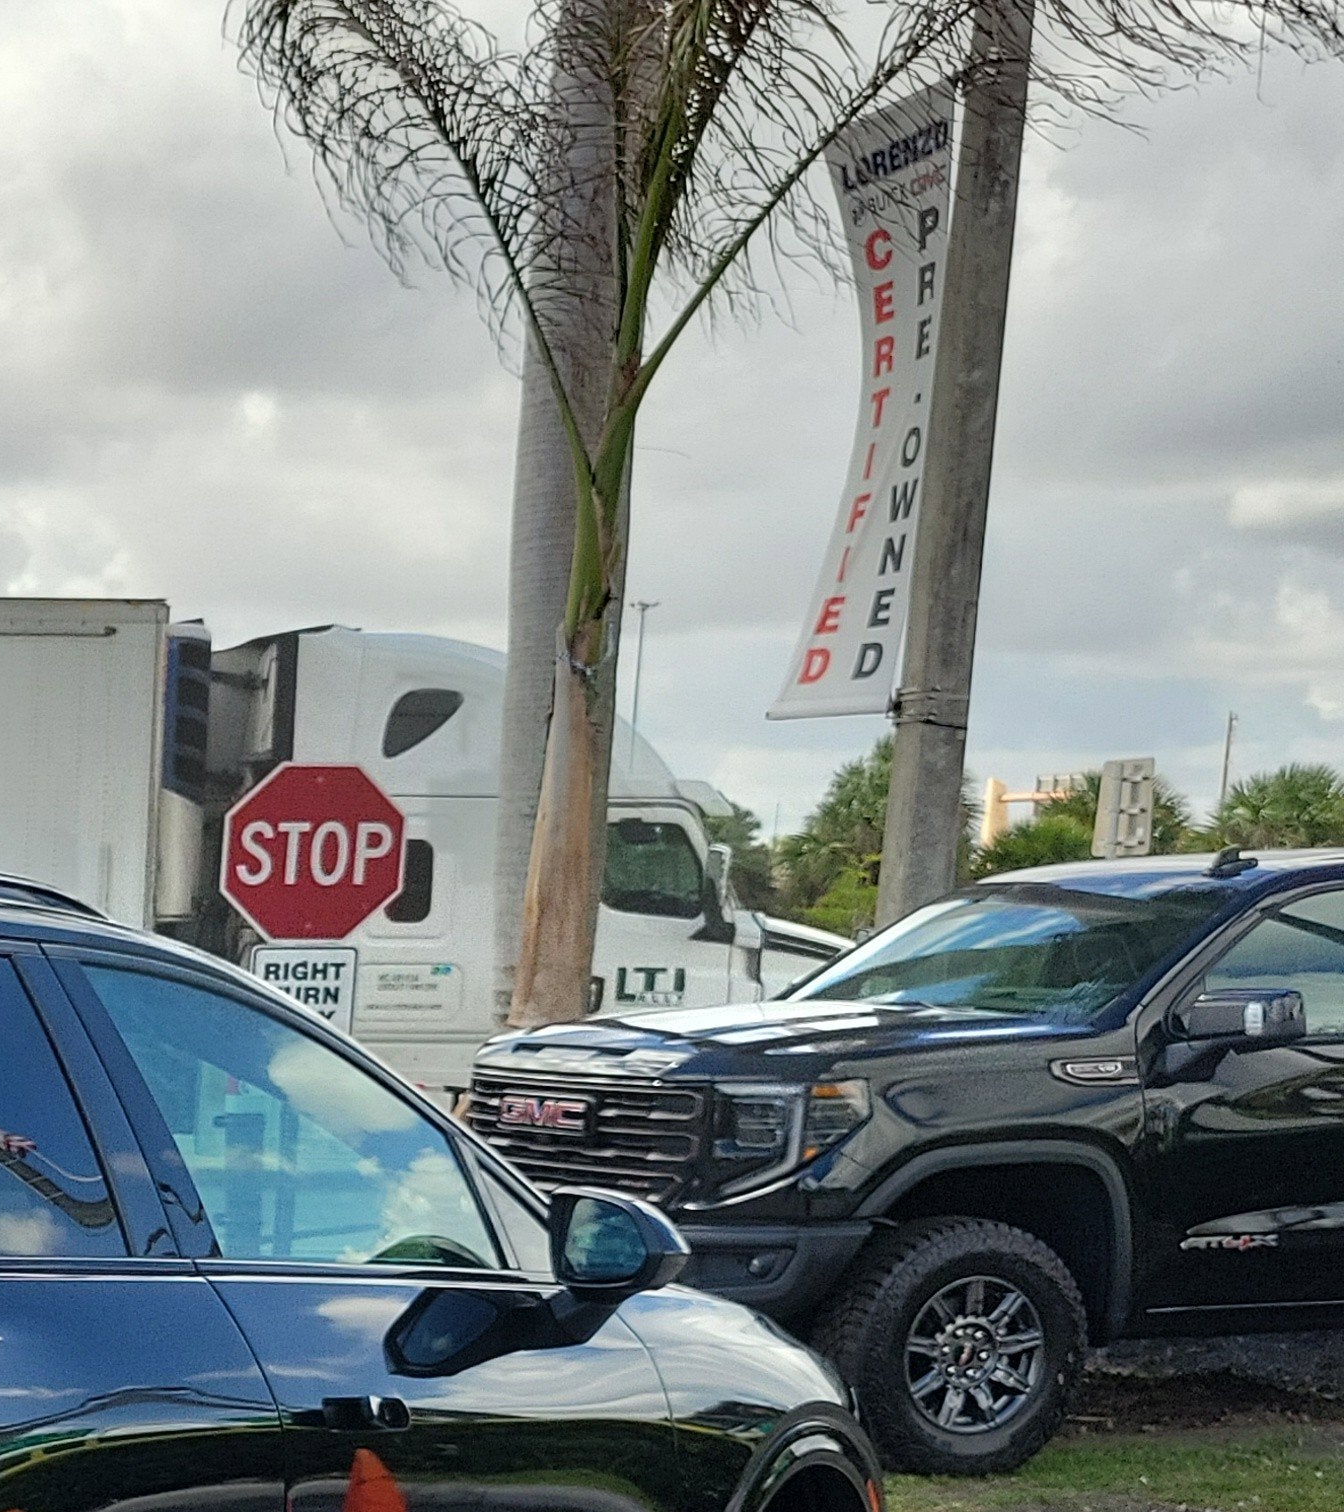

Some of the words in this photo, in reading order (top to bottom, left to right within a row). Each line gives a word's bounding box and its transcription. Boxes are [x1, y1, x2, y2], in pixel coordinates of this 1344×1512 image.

[841, 120, 949, 192] LORENZO
[799, 229, 893, 684] CERTIFIED
[235, 820, 394, 887] STOP
[264, 962, 347, 981] RIGHT
[499, 1096, 588, 1131] GMC
